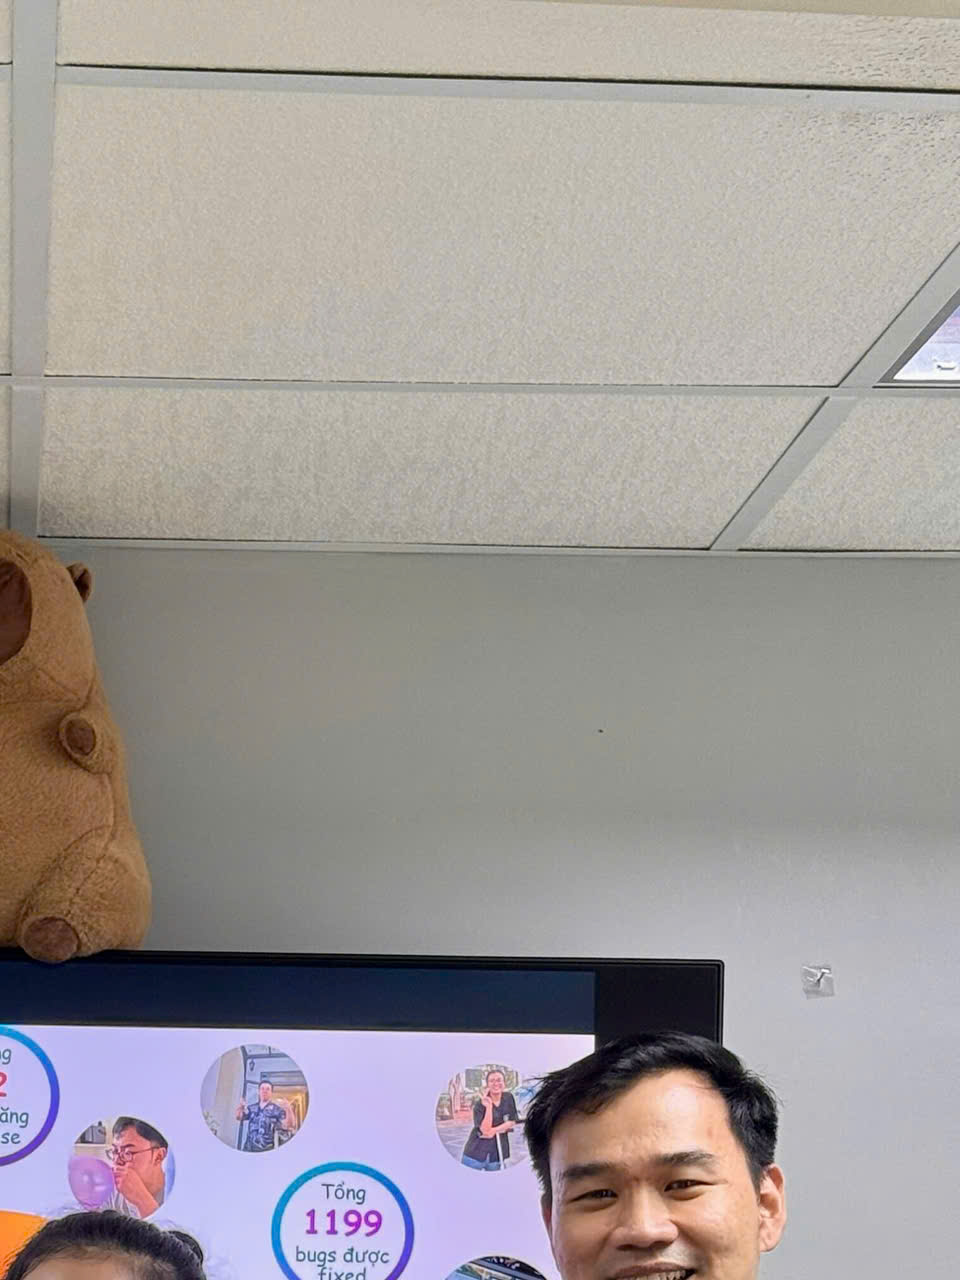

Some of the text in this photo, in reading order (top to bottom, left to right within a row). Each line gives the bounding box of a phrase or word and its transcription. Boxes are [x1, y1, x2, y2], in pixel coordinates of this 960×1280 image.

[321, 1181, 366, 1205] Tổng
[305, 1208, 383, 1237] 1199
[295, 1245, 390, 1268] bugs được
